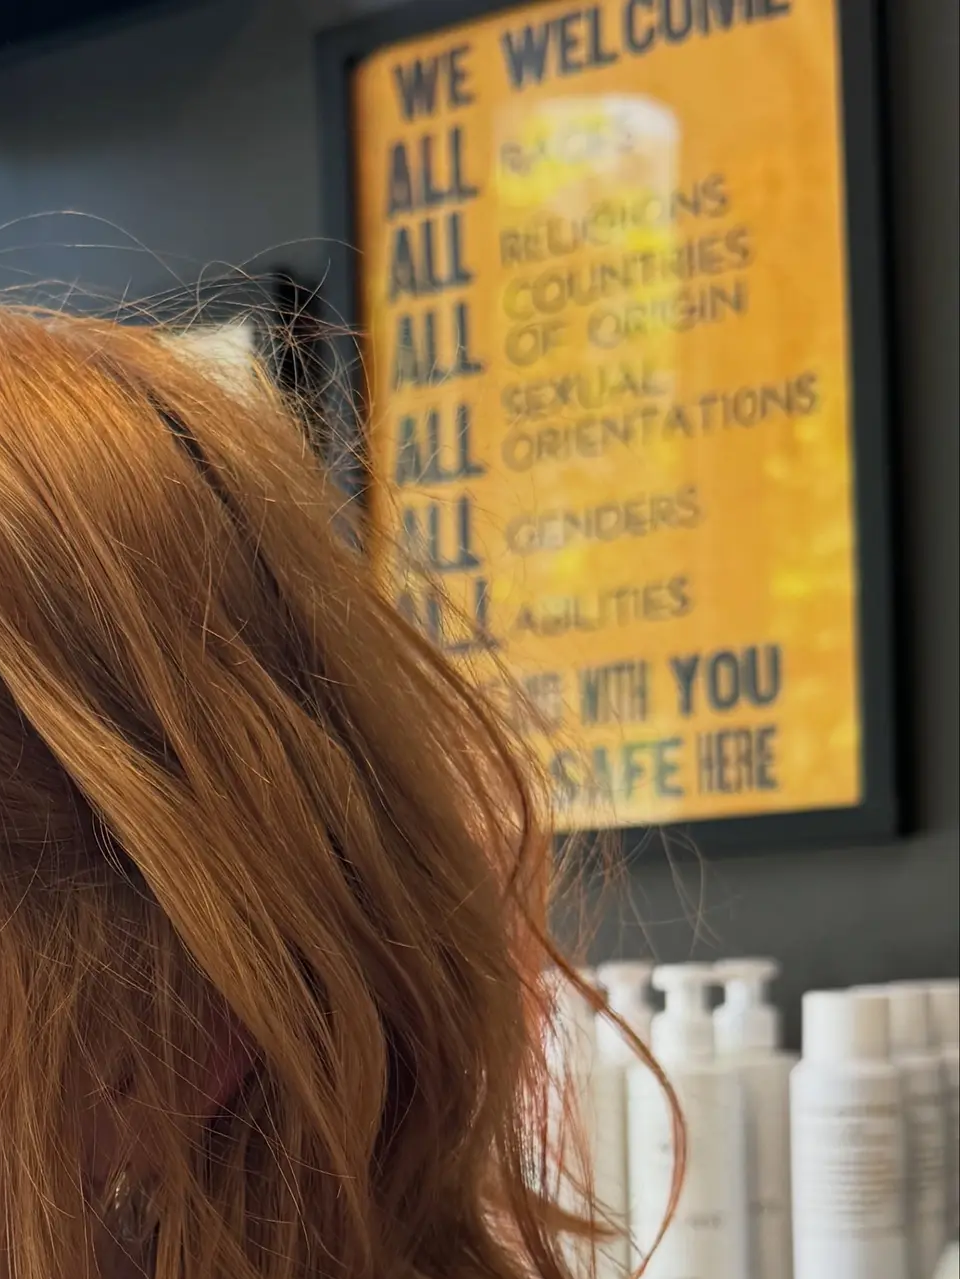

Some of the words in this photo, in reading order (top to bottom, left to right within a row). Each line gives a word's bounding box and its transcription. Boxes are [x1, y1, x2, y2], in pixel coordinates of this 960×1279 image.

[393, 44, 476, 123] WE
[501, 0, 792, 91] WELCOM
[387, 128, 480, 220] ALL
[388, 213, 474, 301] ALL
[393, 303, 483, 393] ALL
[502, 228, 754, 322] COUNTRIES
[504, 320, 567, 367] OF
[586, 279, 749, 351] ORIGIN
[395, 402, 487, 487] ALL
[500, 366, 668, 420] SEXUAL
[500, 369, 819, 474] ORIENTATIONS
[504, 485, 704, 557] GENDERS
[515, 575, 696, 637] ABILITIES
[578, 660, 648, 727] WITH
[670, 642, 782, 718] YOU
[695, 723, 780, 796] HERE
